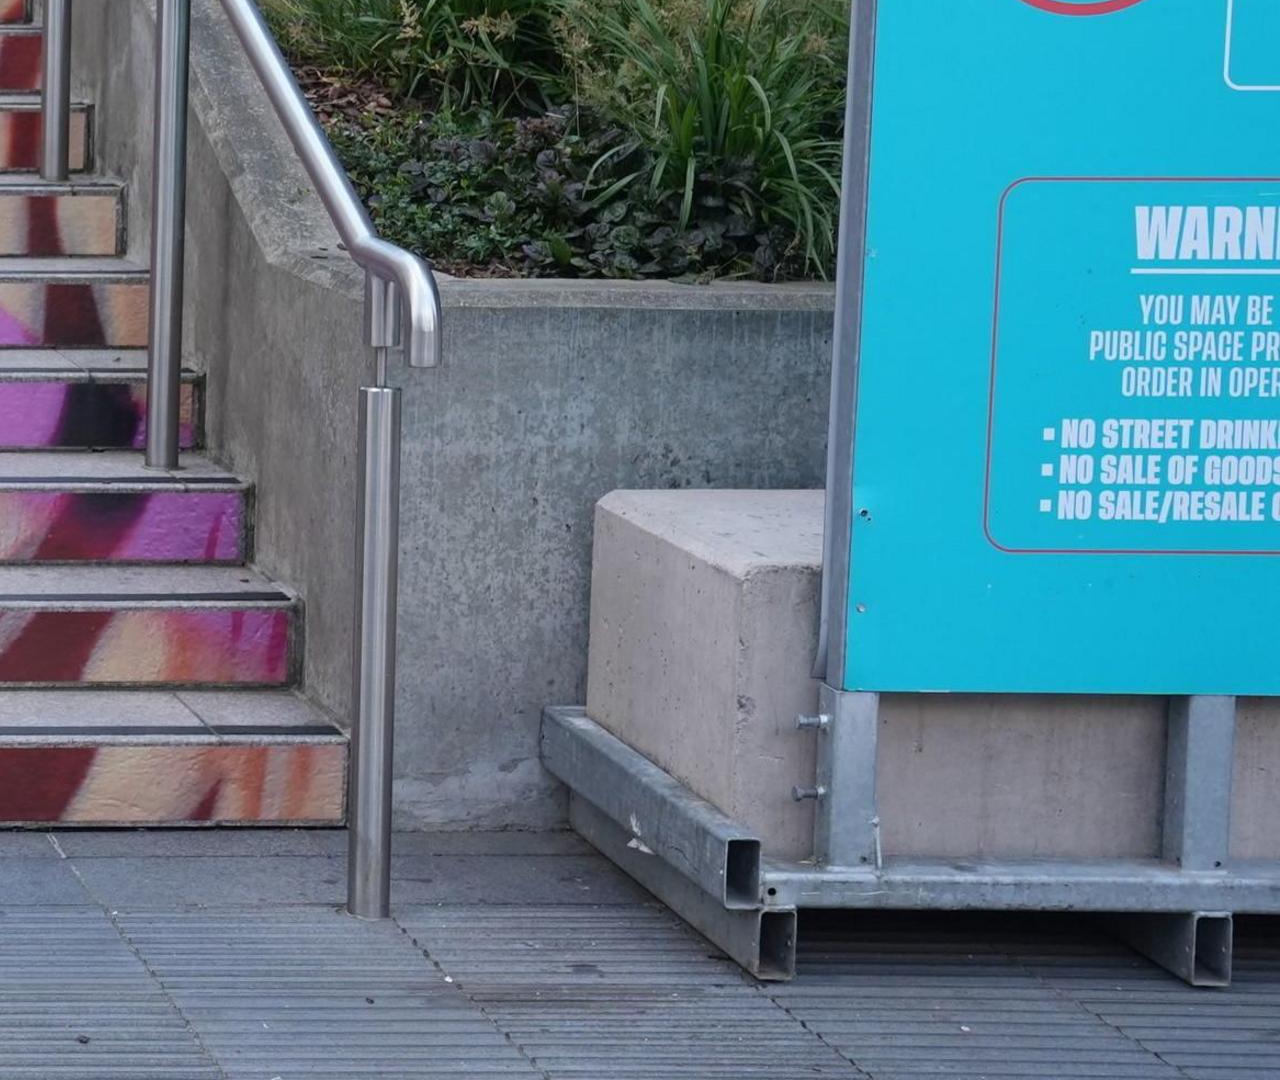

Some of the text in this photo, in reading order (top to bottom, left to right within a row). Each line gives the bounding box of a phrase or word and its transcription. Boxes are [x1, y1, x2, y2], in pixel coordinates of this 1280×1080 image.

[1140, 295, 1274, 325] YOU MAY BE
[1089, 330, 1167, 361] PUBLIC
[1173, 331, 1244, 361] SPACE
[1121, 366, 1193, 397] ORDER
[1199, 367, 1222, 397] IN
[1061, 419, 1280, 450] NO STREET DRINK
[1059, 454, 1094, 484] NO
[1100, 454, 1161, 485] SALE
[1167, 455, 1199, 485] OF
[1057, 490, 1092, 519] NO
[1098, 490, 1266, 524] SALE/RESALE
